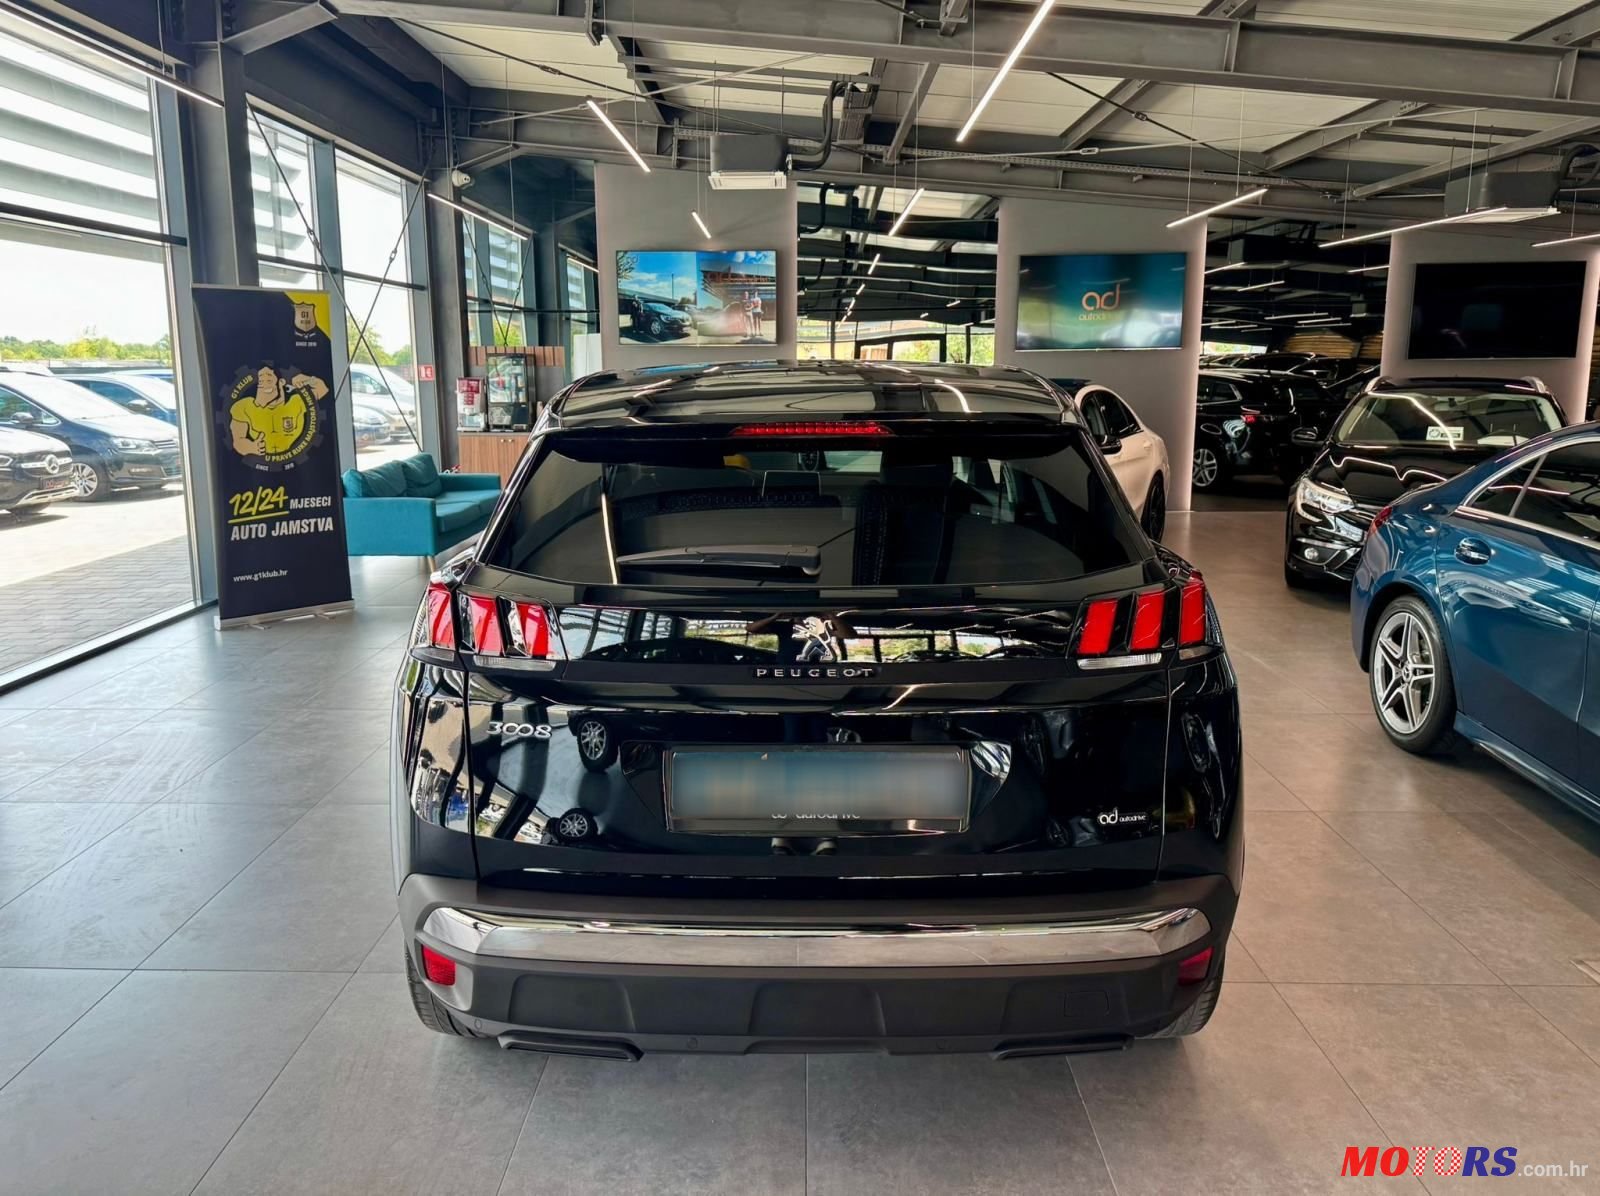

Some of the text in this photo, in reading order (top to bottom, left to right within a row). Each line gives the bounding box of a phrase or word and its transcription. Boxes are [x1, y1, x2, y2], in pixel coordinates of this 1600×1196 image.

[1082, 283, 1120, 311] ad
[231, 375, 253, 399] G1 KLUB
[272, 452, 293, 461] PRAVE
[292, 441, 308, 456] RUKE
[229, 486, 331, 516] 12/24 MJESECI
[230, 517, 334, 541] AUTO JAMSTVA
[233, 569, 288, 582] www.g1klub.hr
[756, 668, 873, 677] PEUGEOT
[486, 721, 552, 739] 3008
[1099, 807, 1146, 825] ad autodrive
